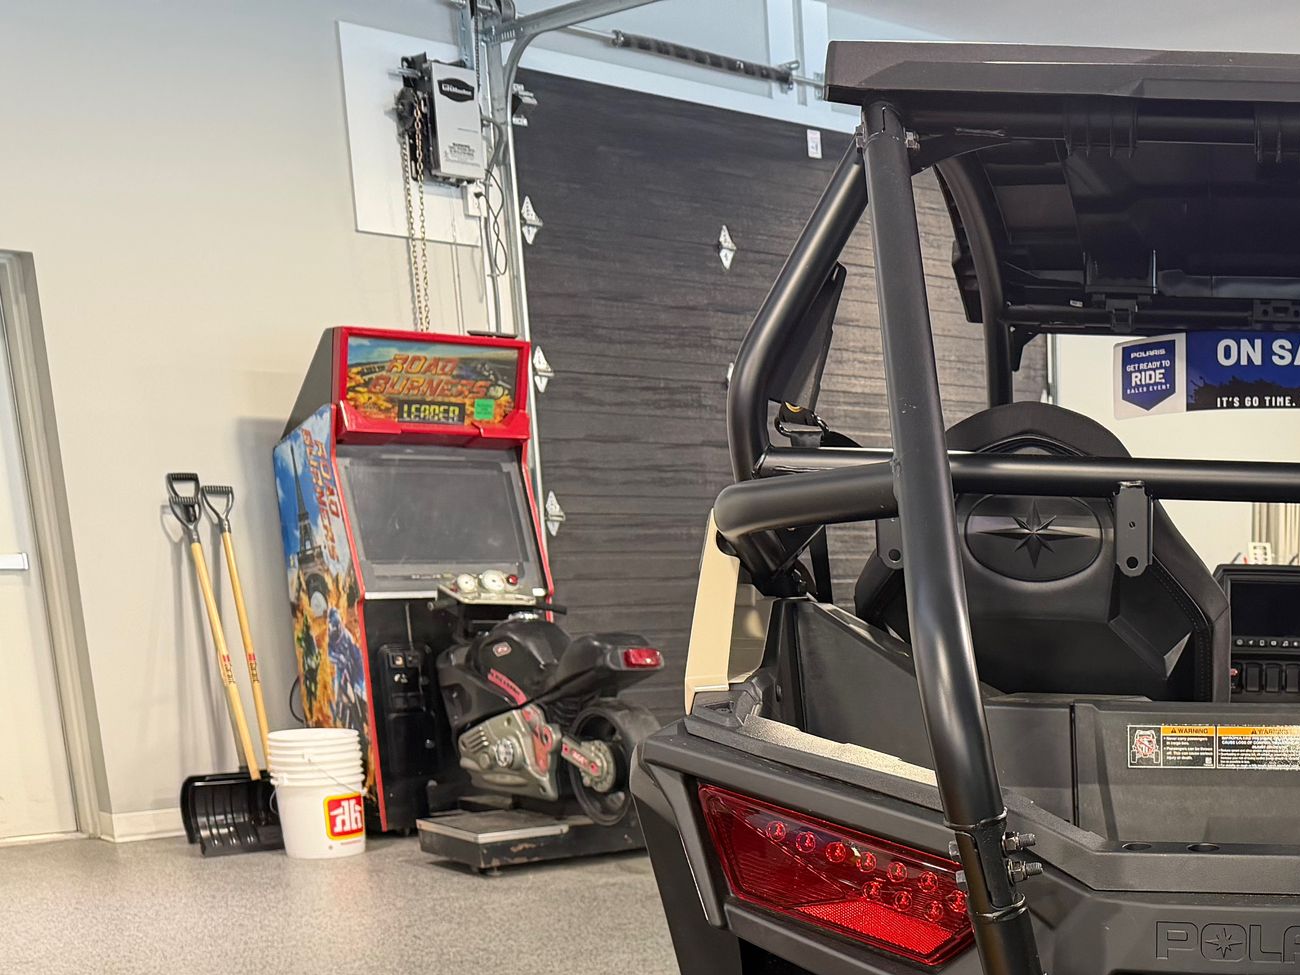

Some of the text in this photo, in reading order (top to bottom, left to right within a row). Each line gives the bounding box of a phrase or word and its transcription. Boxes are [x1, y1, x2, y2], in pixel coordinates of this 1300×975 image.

[1130, 348, 1167, 359] POLARIS
[1216, 338, 1262, 367] ON
[385, 353, 459, 376] ROAD
[1126, 359, 1171, 372] GET READY TO
[368, 374, 492, 399] BURNERS
[1131, 368, 1166, 387] RIDE
[1127, 383, 1170, 395] SALES EVENT
[1216, 396, 1240, 408] IT'S
[1244, 396, 1260, 407] GO
[1264, 396, 1297, 407] TIME.
[403, 403, 460, 422] LEADER
[313, 439, 341, 519] ROAD
[301, 427, 340, 562] BURNERS
[1177, 727, 1209, 735] WARNING
